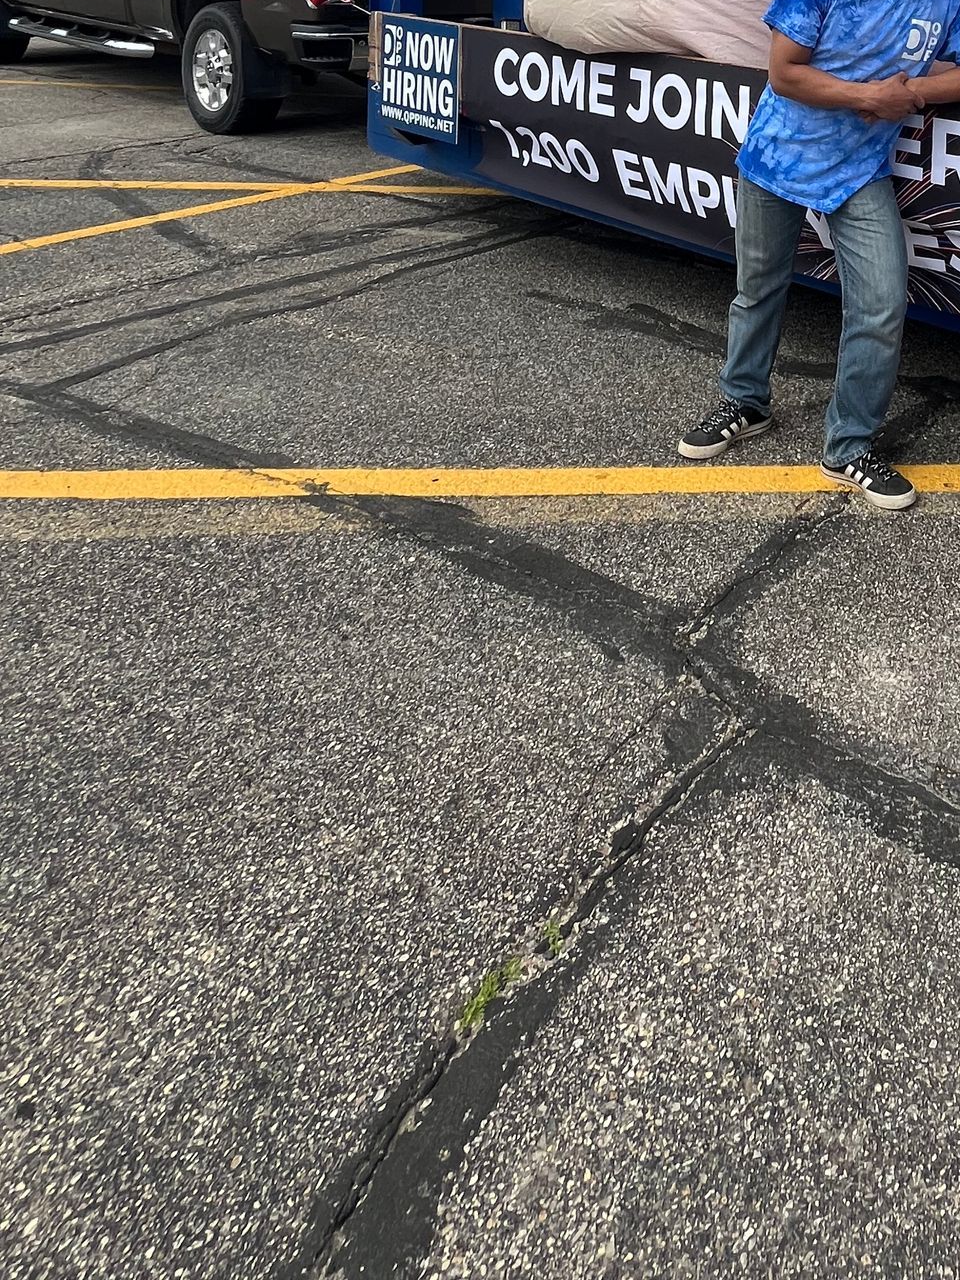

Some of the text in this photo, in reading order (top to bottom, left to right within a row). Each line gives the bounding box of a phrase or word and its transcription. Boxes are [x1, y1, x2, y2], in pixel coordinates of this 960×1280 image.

[405, 31, 455, 75] NOW
[382, 67, 454, 118] HIRING
[493, 47, 616, 118] COME
[625, 67, 750, 144] JOIN
[381, 104, 455, 134] WWW.QPPINC.NET
[488, 119, 600, 183] 1,200
